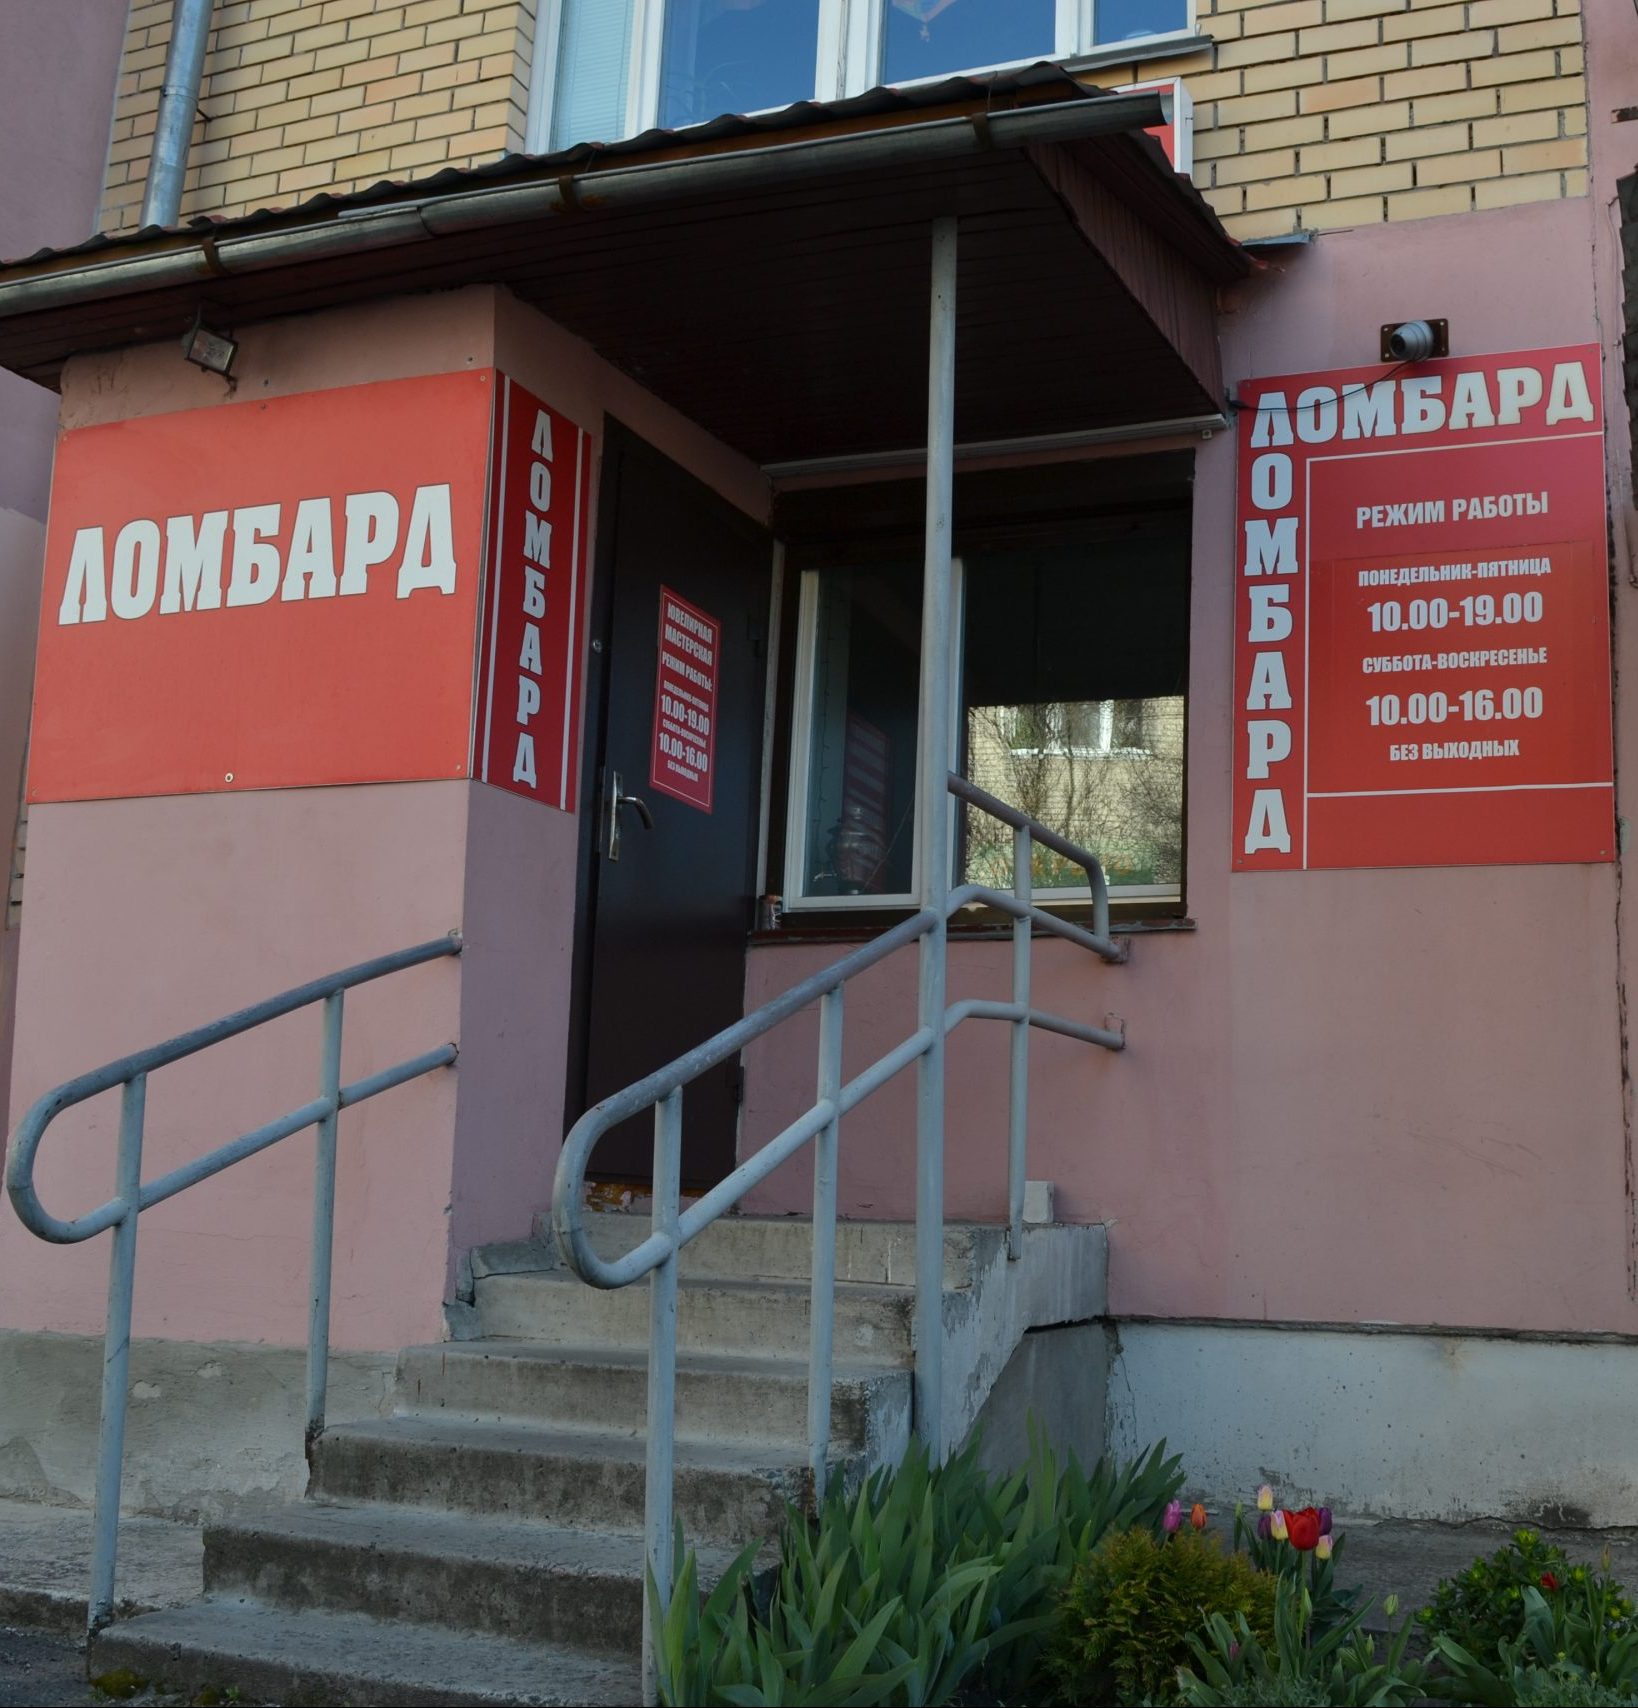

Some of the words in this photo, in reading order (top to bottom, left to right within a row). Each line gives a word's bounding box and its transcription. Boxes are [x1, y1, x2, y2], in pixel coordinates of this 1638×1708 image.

[1250, 361, 1595, 448] ЛОМБАРД
[1356, 500, 1445, 529] РЕЖИМ
[1452, 491, 1548, 521] РАБОТЫ
[58, 483, 457, 626] ЛОМБАРД
[1358, 557, 1551, 587] ПОНЕДЕЛЬНИК-ПЯТНИЦА
[512, 409, 554, 789] ЛОМБАРД
[1367, 591, 1543, 632] 10.00-19.00
[1362, 646, 1548, 674] СУББОТА-ВОСКРЕСЕНЬЕ
[660, 694, 710, 736] 10.00-19.00
[1366, 686, 1543, 726] 10.00-16.00
[658, 732, 708, 773] 10.00-16.00
[1390, 744, 1418, 761] БЕЗ
[1422, 739, 1520, 760] ВЫХОДНЫХ
